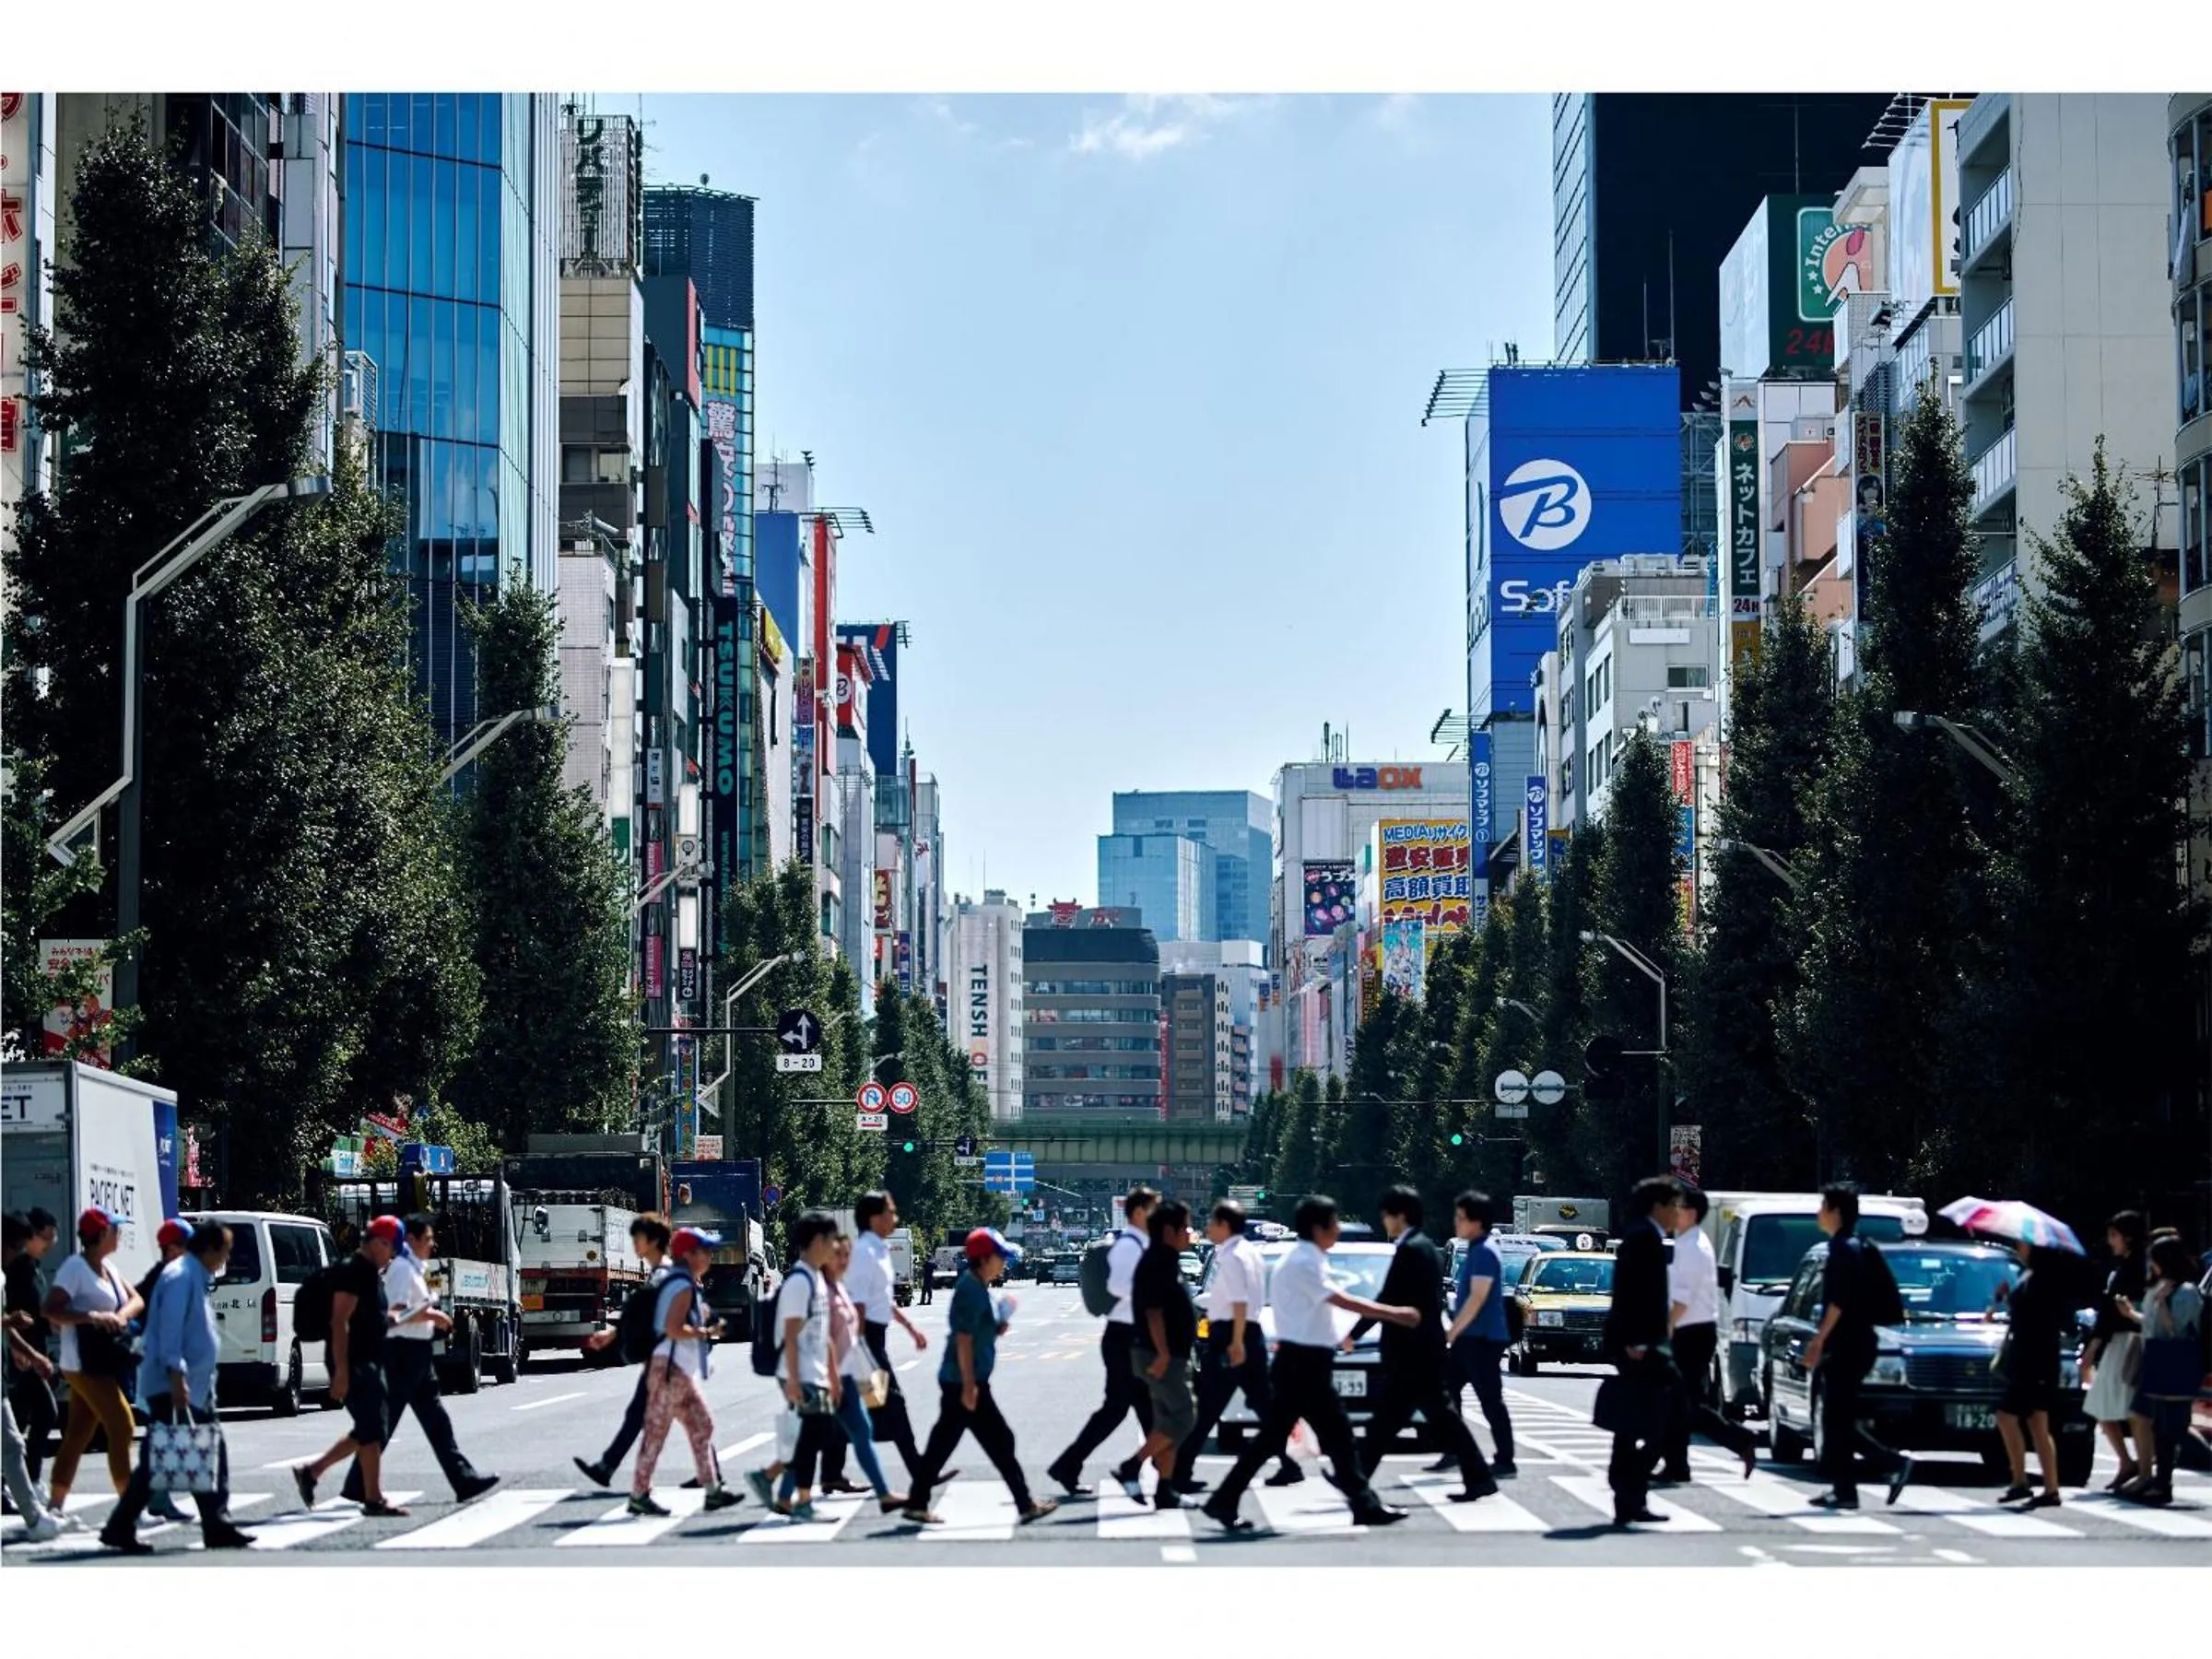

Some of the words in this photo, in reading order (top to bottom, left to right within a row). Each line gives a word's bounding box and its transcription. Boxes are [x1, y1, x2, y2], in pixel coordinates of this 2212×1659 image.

[1735, 463, 1757, 584] ネットカフェ
[716, 620, 733, 796] TSUKUMO
[1476, 780, 1489, 827] ソフマップ
[1529, 806, 1544, 859] ソフマップ
[895, 1091, 911, 1105] 50
